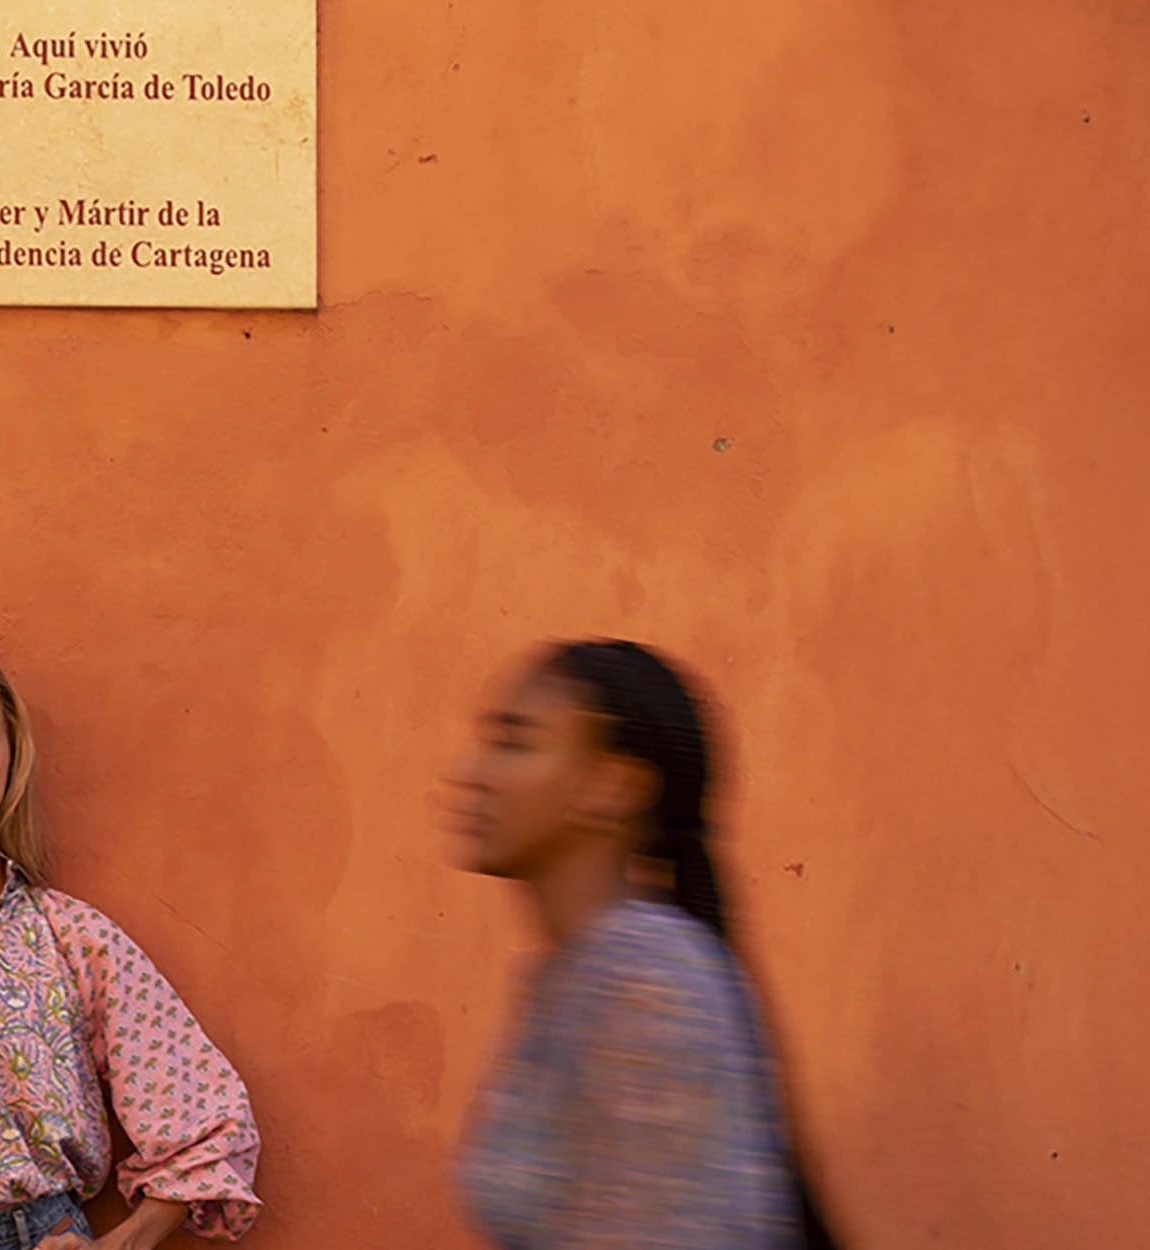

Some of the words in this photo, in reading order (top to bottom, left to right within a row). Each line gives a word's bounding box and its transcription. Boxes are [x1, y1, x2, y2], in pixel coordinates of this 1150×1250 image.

[10, 32, 75, 65] Aquí
[85, 32, 147, 59] vivió
[44, 72, 134, 99] García
[144, 74, 174, 100] de
[182, 74, 270, 101] Toledo
[34, 207, 49, 232] y
[58, 199, 150, 226] Mártir
[158, 200, 188, 226] de
[198, 201, 220, 226] la
[91, 241, 122, 267] de
[131, 241, 270, 275] Cartagena
